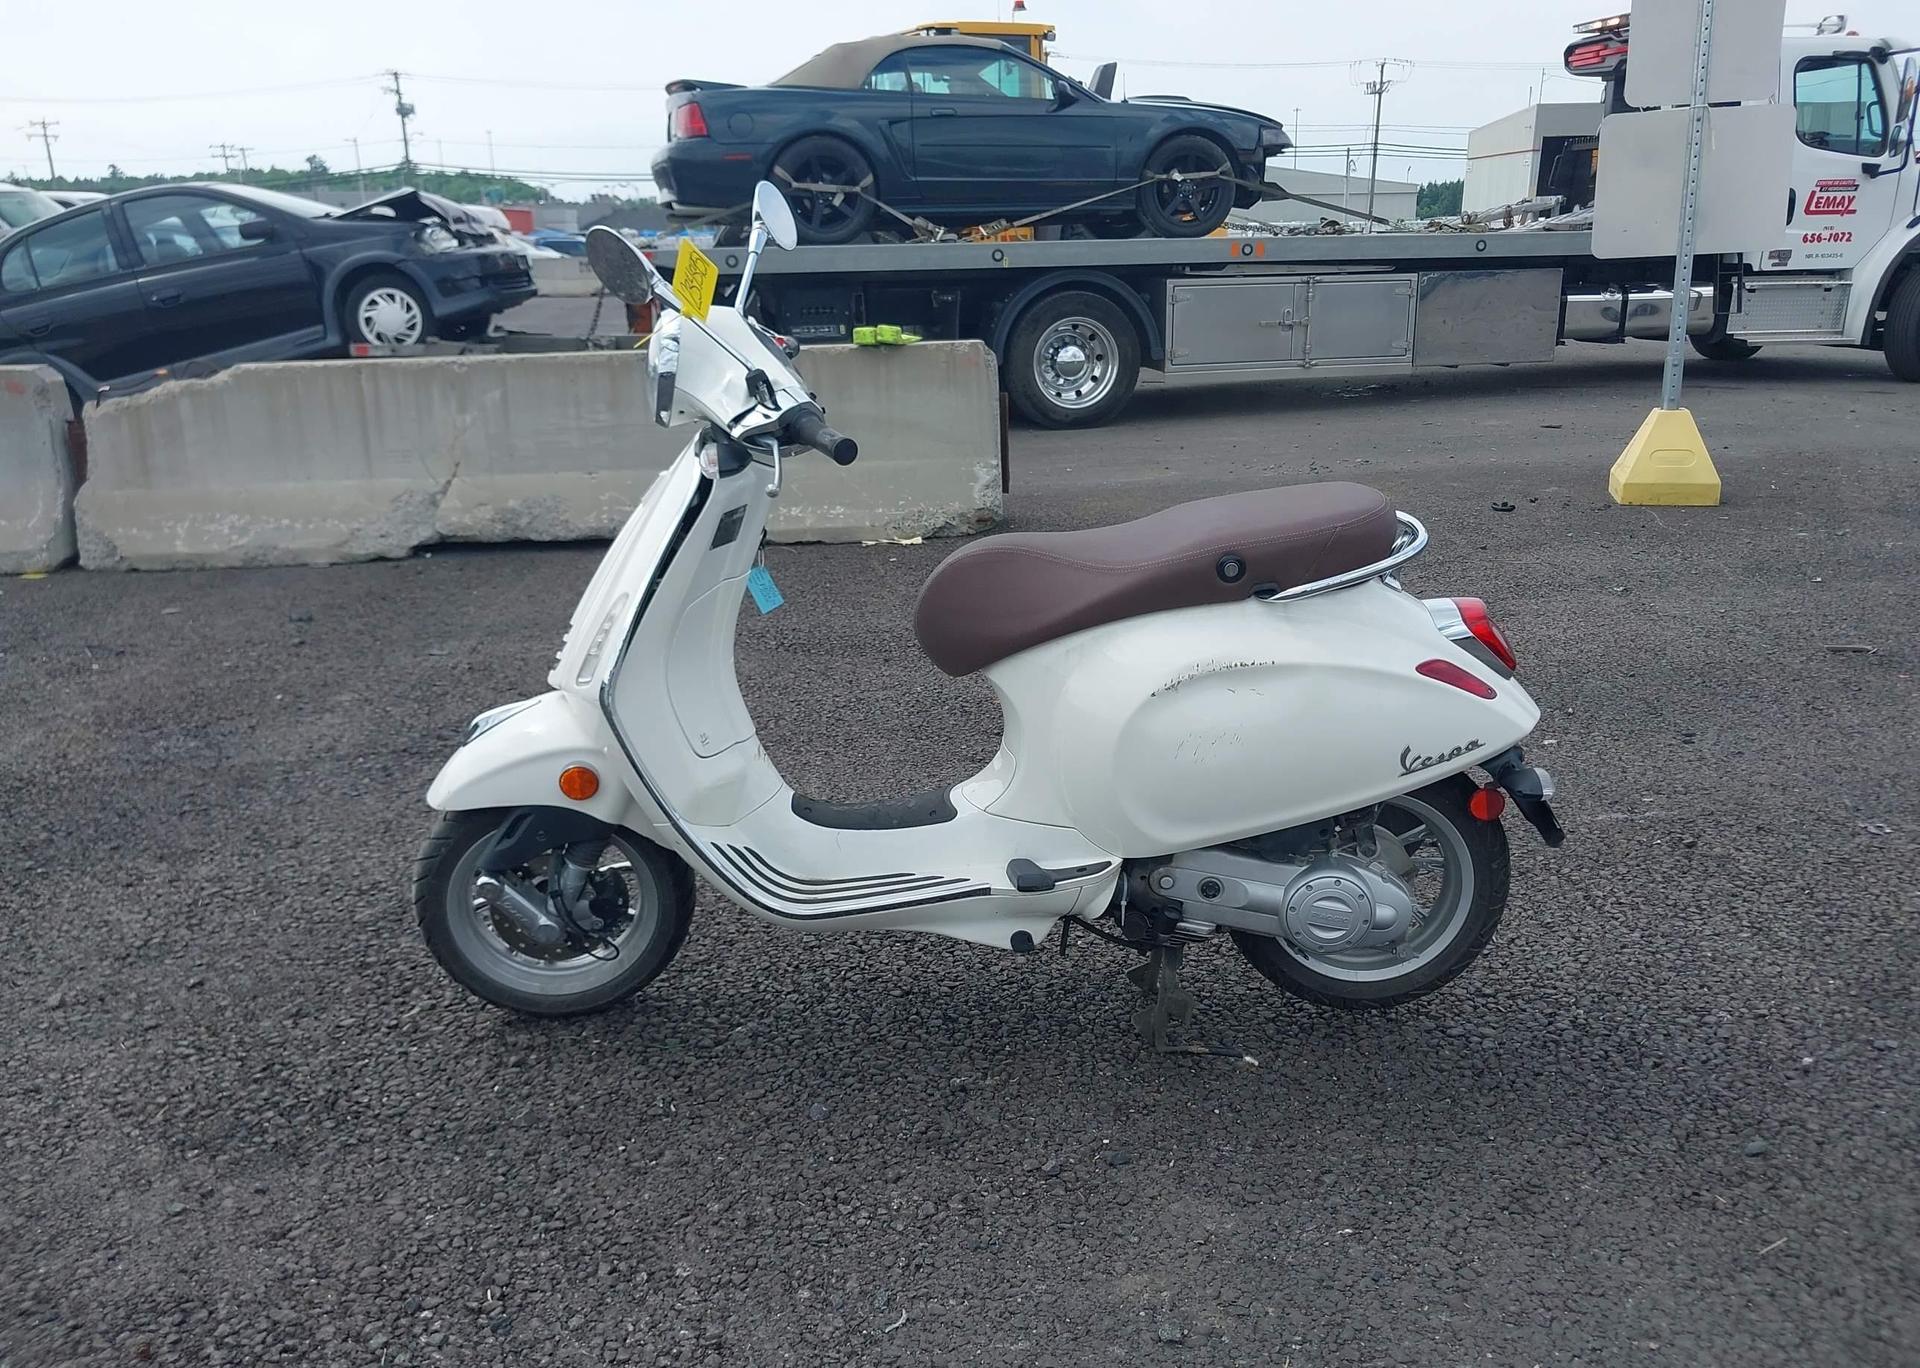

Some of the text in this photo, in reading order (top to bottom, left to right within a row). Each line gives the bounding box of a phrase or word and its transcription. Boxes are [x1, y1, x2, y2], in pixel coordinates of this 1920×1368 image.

[1804, 190, 1857, 216] LEMAY
[1802, 232, 1853, 244] 656-1072
[1398, 738, 1486, 778] Vespa
